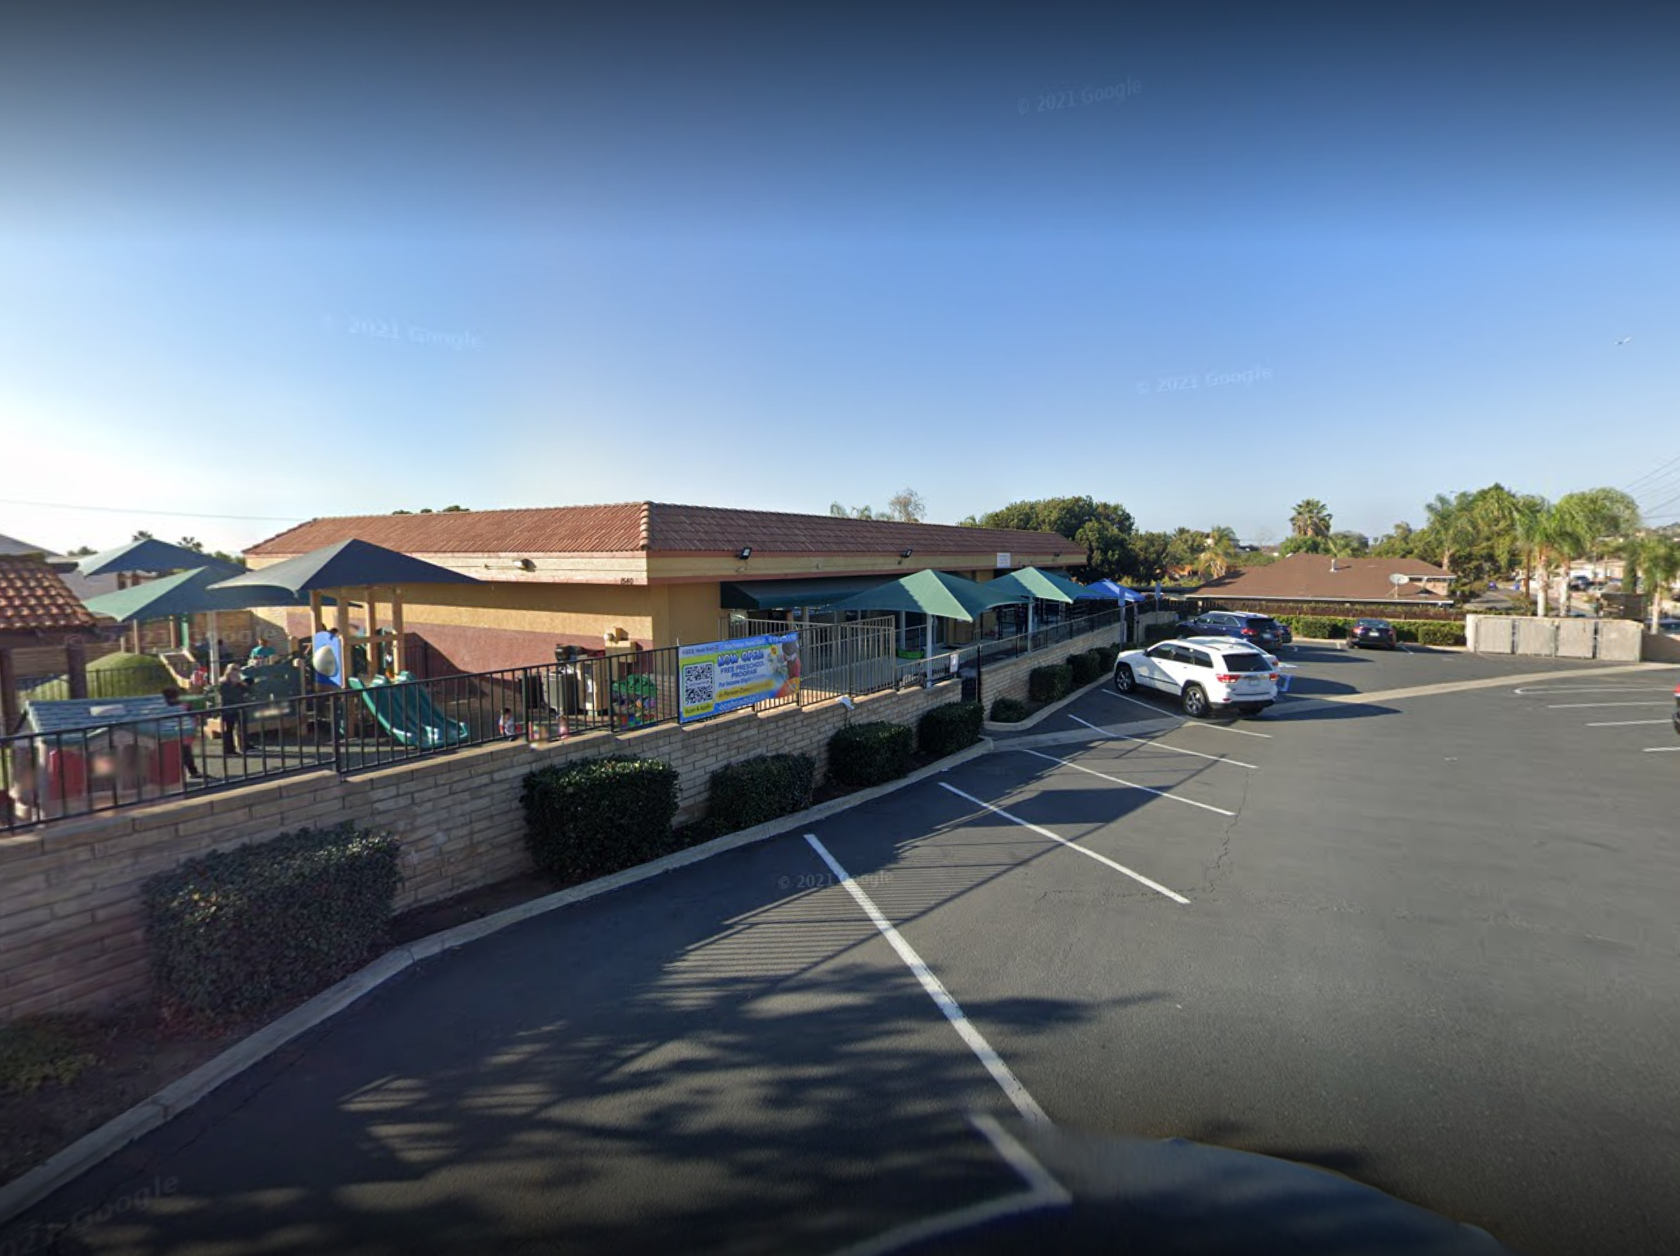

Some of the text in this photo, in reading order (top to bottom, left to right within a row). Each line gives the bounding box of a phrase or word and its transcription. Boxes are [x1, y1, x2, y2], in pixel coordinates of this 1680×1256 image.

[717, 649, 765, 667] NOW OPEN
[720, 661, 765, 674] FREE PRESCHOOL
[731, 668, 758, 679] PROGRAM
